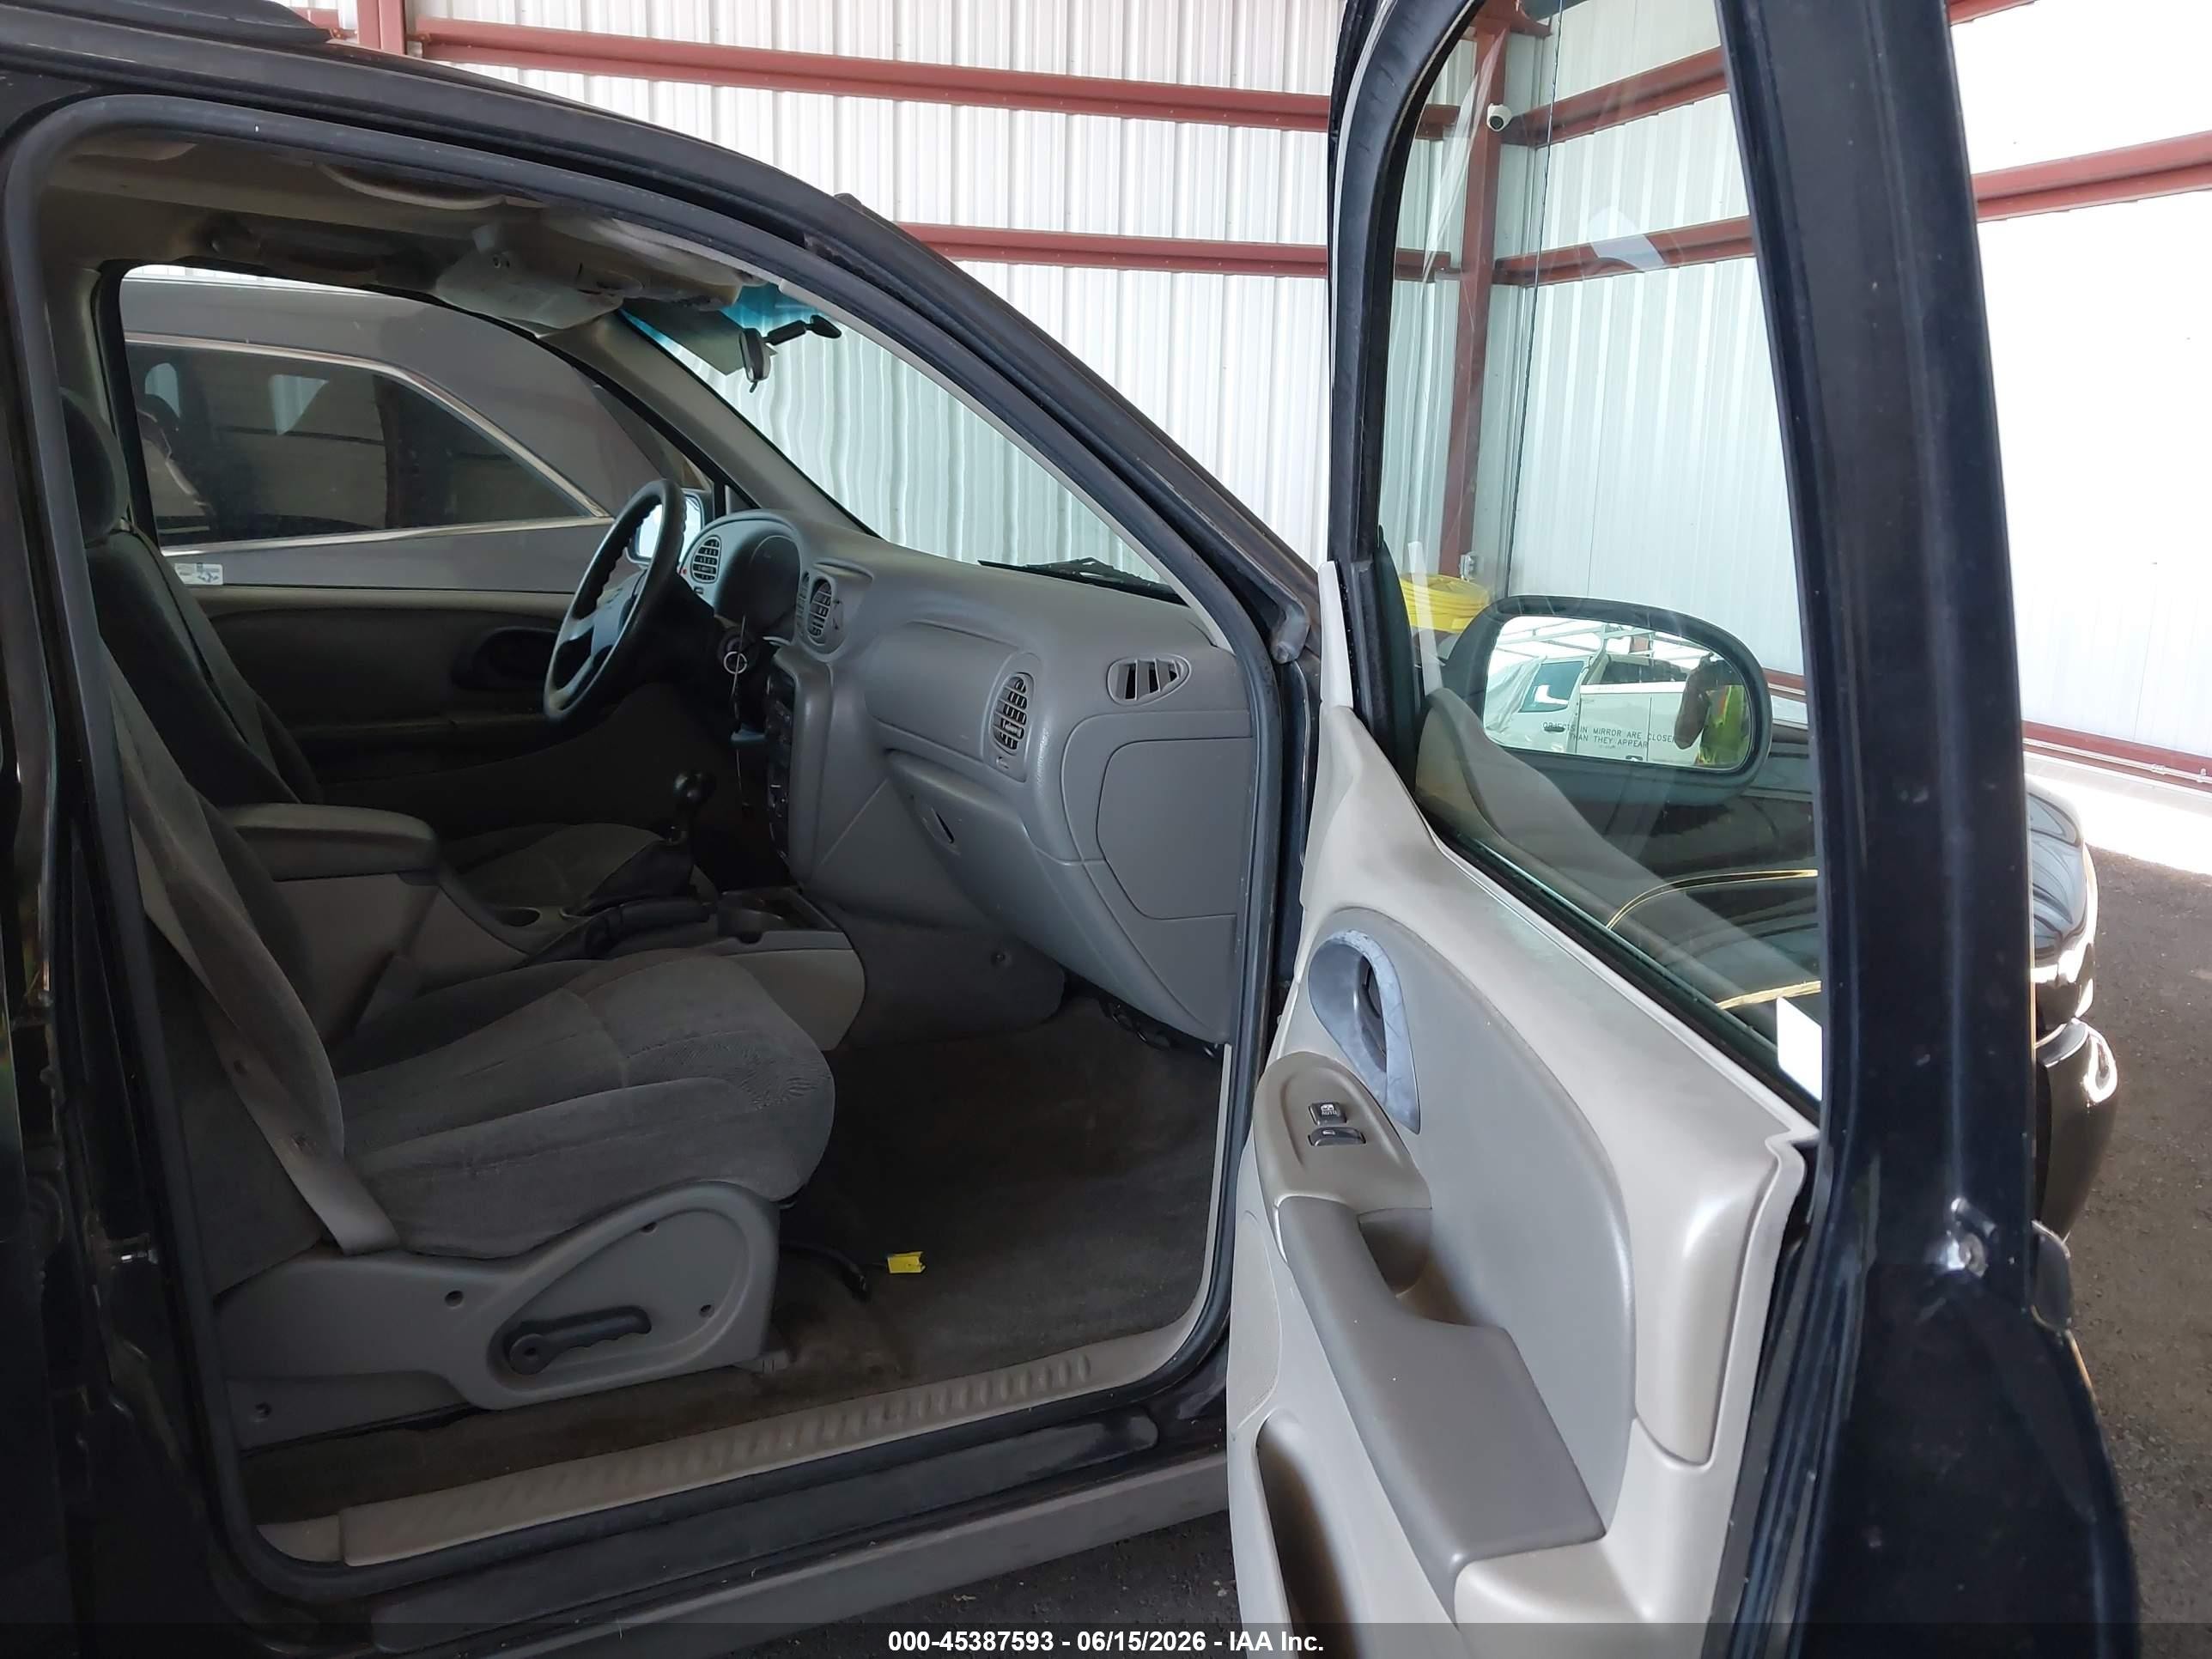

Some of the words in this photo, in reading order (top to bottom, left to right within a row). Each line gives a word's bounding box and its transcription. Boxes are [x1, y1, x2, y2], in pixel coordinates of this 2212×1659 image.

[1593, 727, 1622, 738] MIRROR
[1626, 731, 1643, 740] ARE
[1570, 733, 1589, 742] THAN
[1594, 735, 1613, 744] THEY
[1617, 738, 1649, 749] APPEAR
